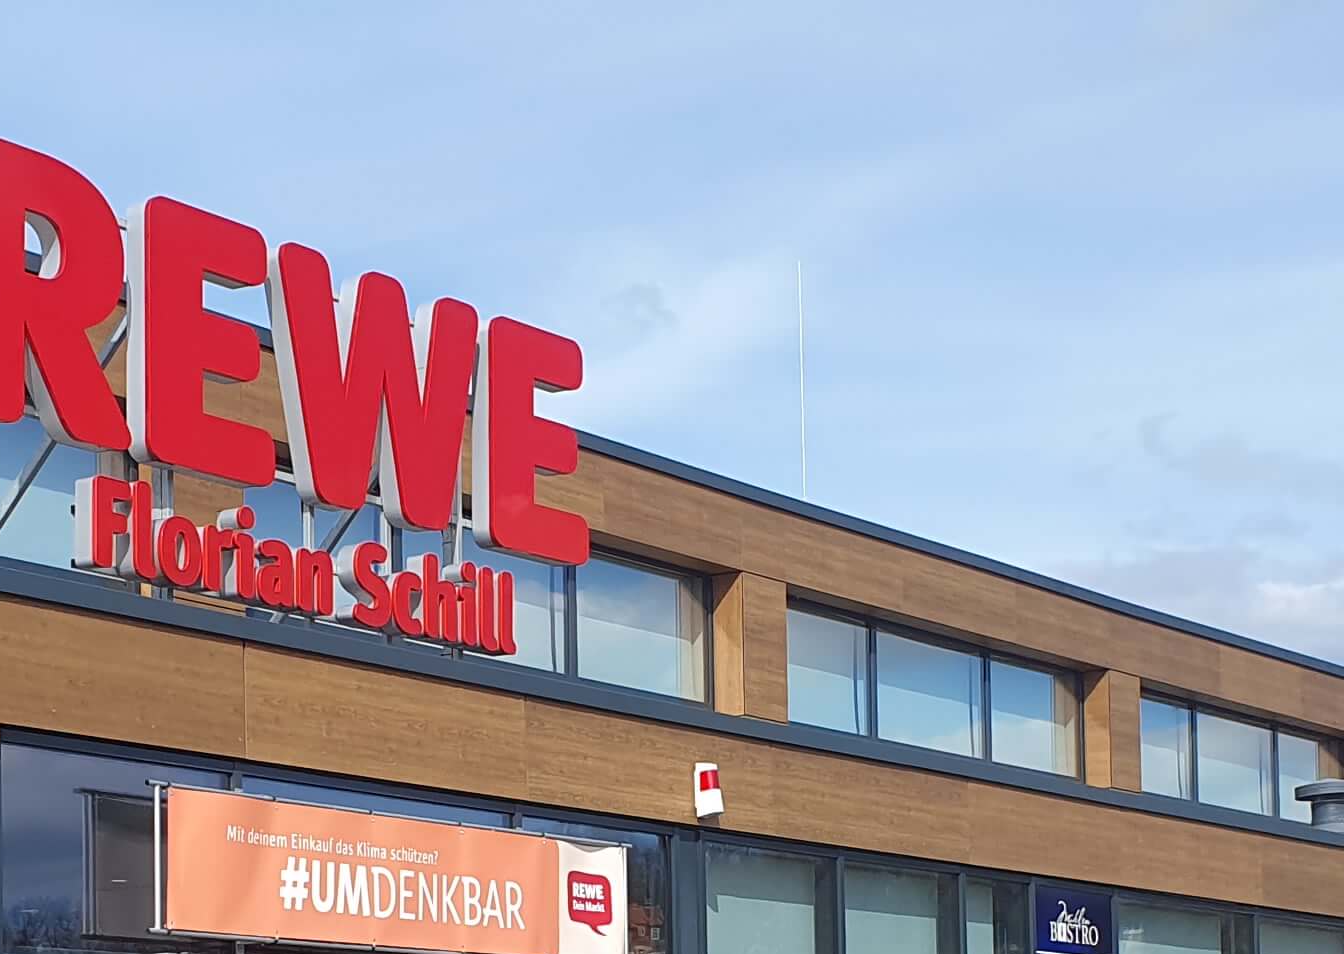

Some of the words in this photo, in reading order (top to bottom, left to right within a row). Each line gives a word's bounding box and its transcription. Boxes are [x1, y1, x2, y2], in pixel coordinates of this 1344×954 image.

[74, 475, 334, 617] Florian
[338, 540, 517, 657] Schill
[226, 825, 245, 842] Mit
[247, 828, 288, 848] deinem
[291, 833, 333, 852] Einkauf
[335, 839, 354, 857] das
[356, 840, 387, 860] Klima
[390, 847, 439, 865] schützen?
[279, 855, 526, 930] #UMDENKBAR
[572, 882, 605, 900] REWE
[586, 901, 605, 913] Markt
[1049, 921, 1099, 946] BISTRO
